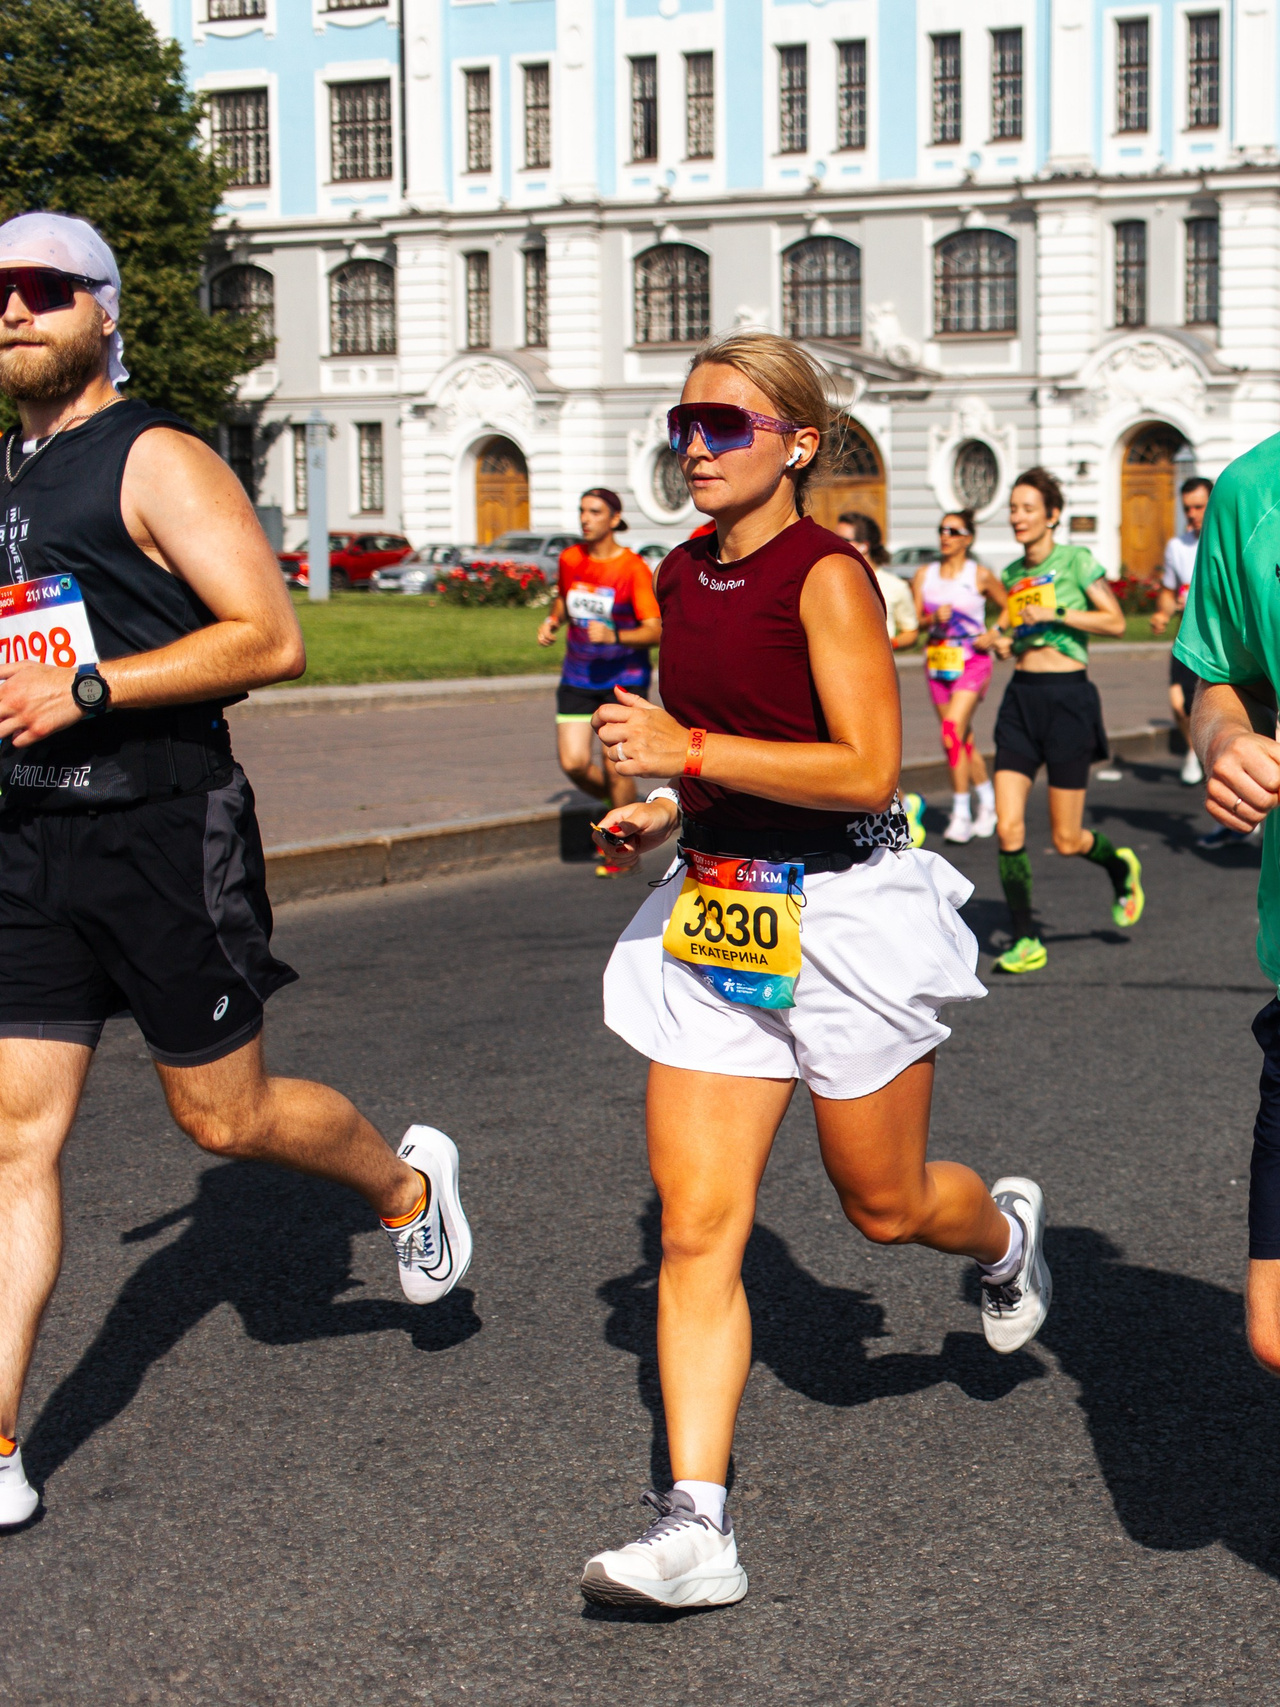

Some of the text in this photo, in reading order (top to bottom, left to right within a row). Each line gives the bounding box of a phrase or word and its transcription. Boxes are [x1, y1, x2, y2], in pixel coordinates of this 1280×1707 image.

[698, 571, 709, 587] No
[726, 578, 745, 590] Run
[690, 731, 703, 757] 3330
[684, 895, 778, 950] 3330
[690, 943, 769, 966] ЕКАТЕРИНА
